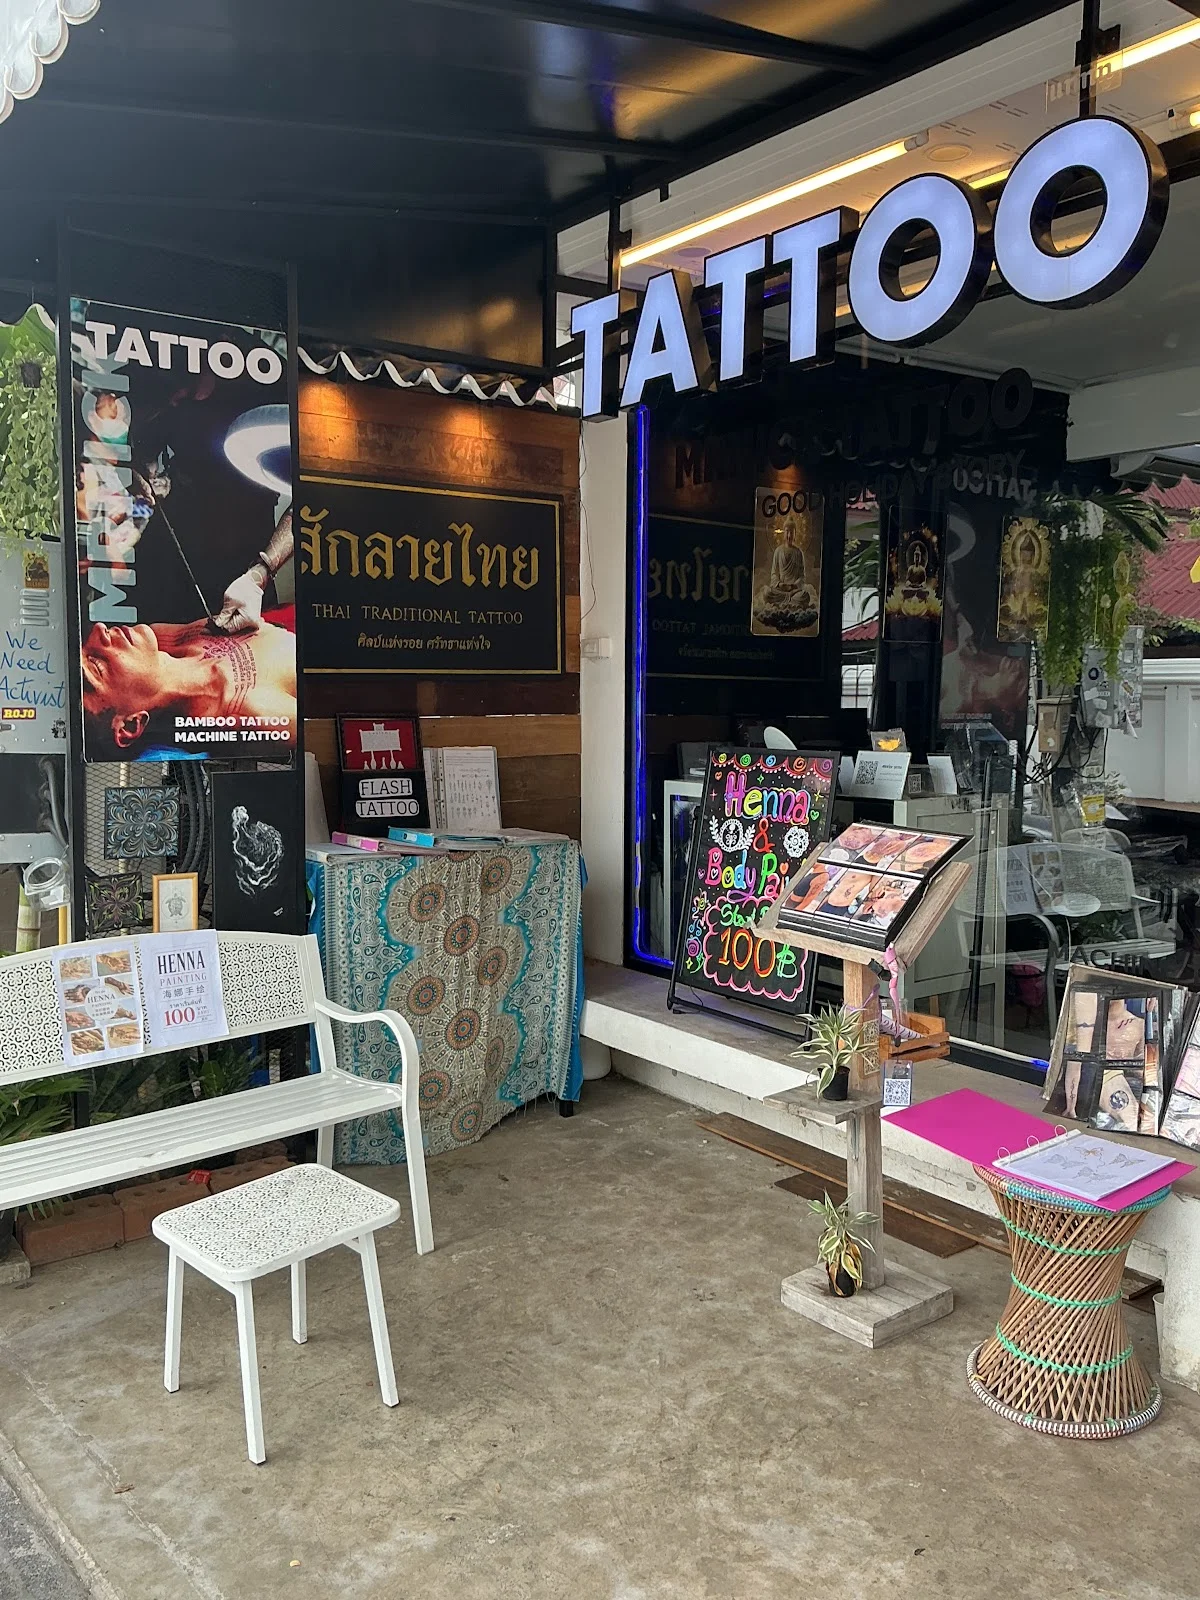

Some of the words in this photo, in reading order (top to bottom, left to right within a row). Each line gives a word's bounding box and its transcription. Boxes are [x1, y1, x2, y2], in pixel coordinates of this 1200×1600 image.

[570, 115, 1160, 420] TATTOO
[86, 319, 282, 386] TATTOO
[762, 490, 823, 519] GOOD
[299, 504, 540, 591] สักลายไทย
[311, 603, 351, 620] THAI
[361, 605, 461, 625] TRADITIONAL
[468, 609, 524, 626] TATTOO
[5, 628, 43, 652] We
[0, 651, 56, 675] Need
[0, 675, 66, 710] Activist
[2, 709, 36, 719] ROJO
[174, 716, 237, 728] BAMBOO
[239, 715, 290, 727] TATTOO
[174, 731, 238, 743] MACHINE
[240, 730, 291, 742] TATTOO
[360, 779, 412, 796] FLASH
[724, 771, 811, 826] Henna
[357, 800, 420, 816] TATTOO
[704, 847, 757, 904] Body
[757, 852, 790, 899] Pai
[157, 951, 206, 975] HENNA
[159, 973, 208, 987] PAINTING
[87, 993, 117, 1004] HENNA
[164, 1006, 196, 1027] 100
